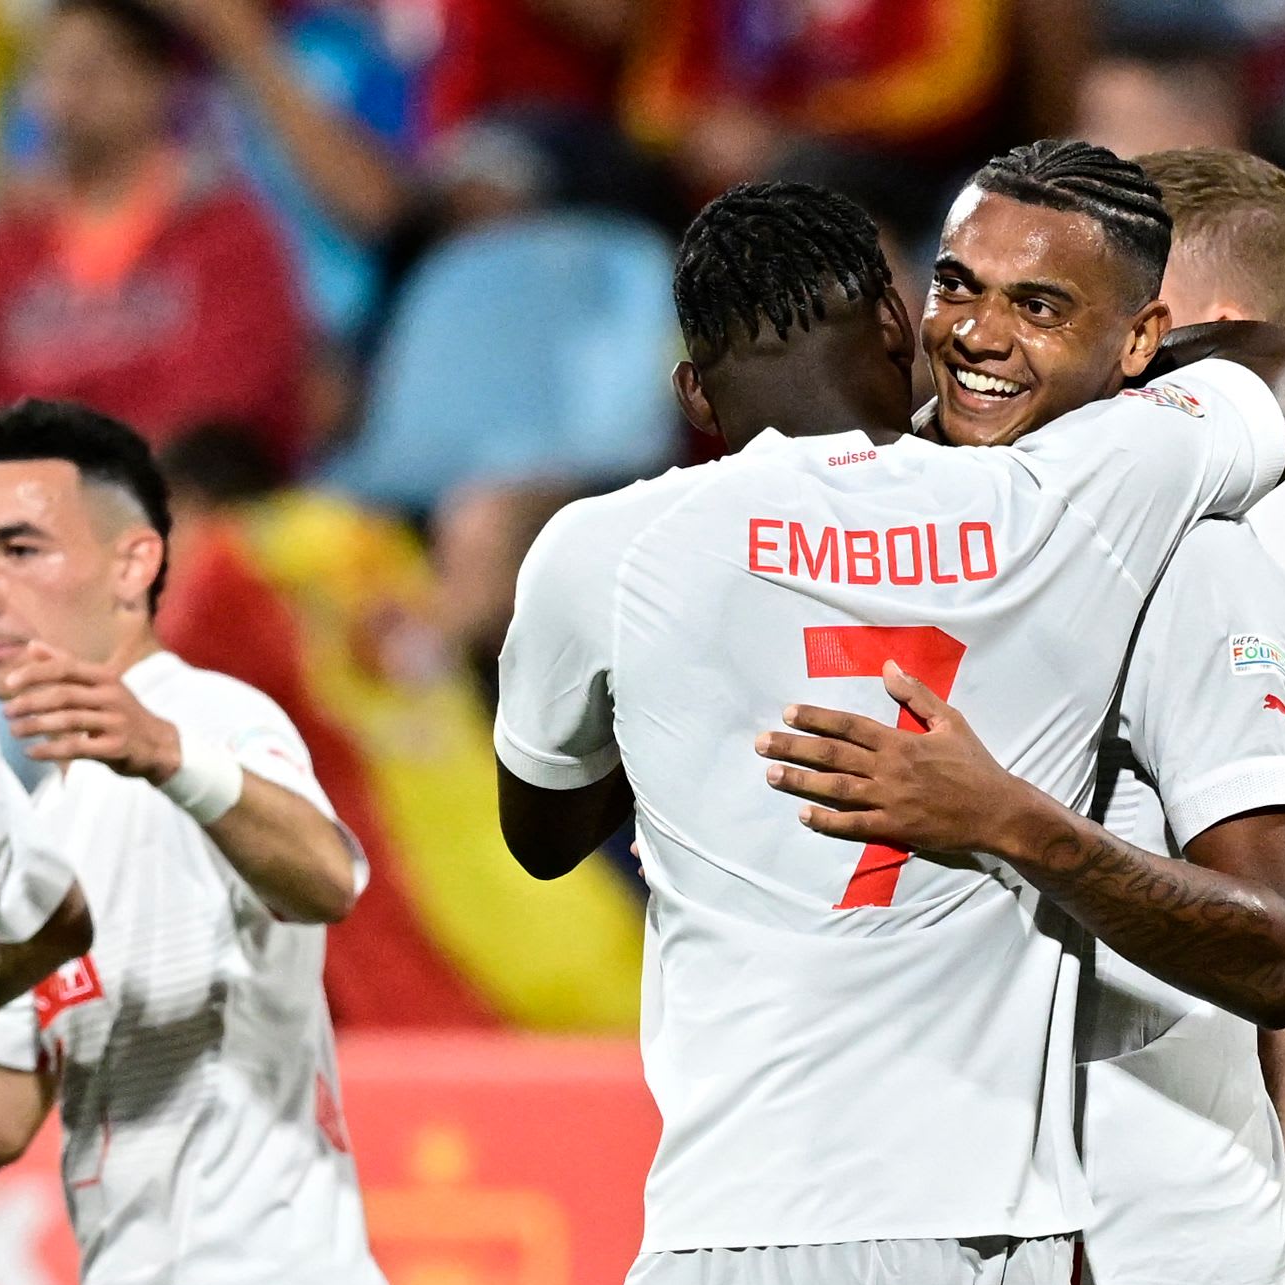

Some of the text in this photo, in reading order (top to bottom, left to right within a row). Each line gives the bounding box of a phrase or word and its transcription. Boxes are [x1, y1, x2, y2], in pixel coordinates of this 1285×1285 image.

[827, 449, 877, 467] suisse
[747, 517, 998, 586] EMBOLO
[1232, 635, 1260, 646] UEFA
[802, 625, 968, 911] 7
